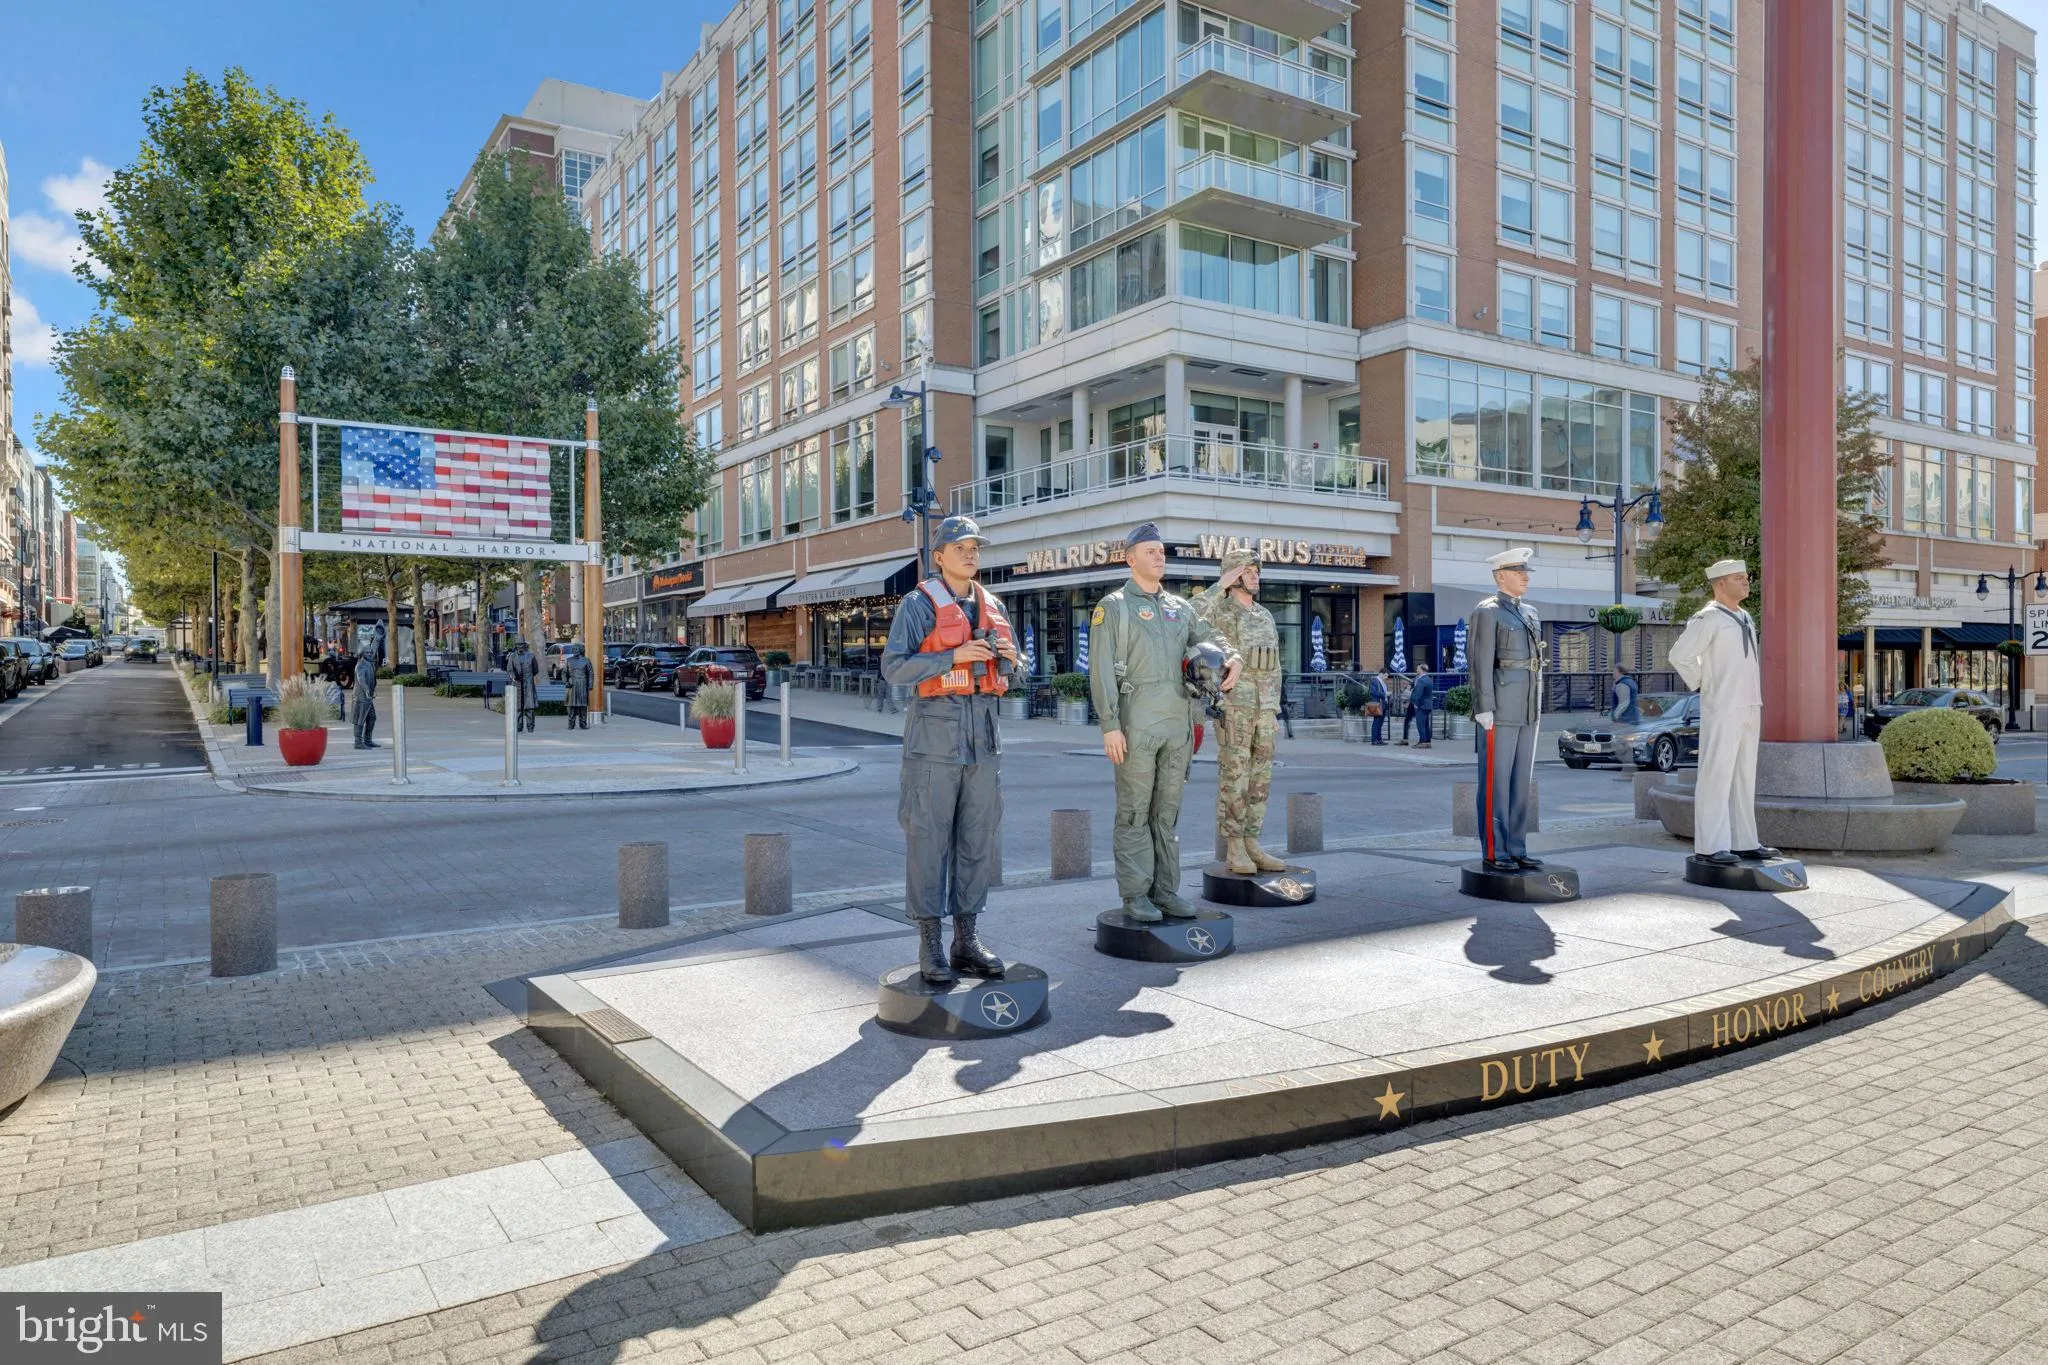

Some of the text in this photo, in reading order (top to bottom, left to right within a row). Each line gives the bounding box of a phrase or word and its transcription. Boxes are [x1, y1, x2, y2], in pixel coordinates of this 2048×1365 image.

[352, 538, 546, 556] NATIONAL HARBOR
[1175, 547, 1200, 558] THE
[1314, 543, 1366, 556] OYSTER &
[1012, 565, 1028, 575] THE
[1026, 540, 1108, 573] WALRUS
[1109, 551, 1126, 563] ALE
[1313, 555, 1367, 568] ALE HOUSE
[2029, 609, 2048, 618] SP
[1480, 944, 1937, 1102] DUTY HONOR COUNTRY
